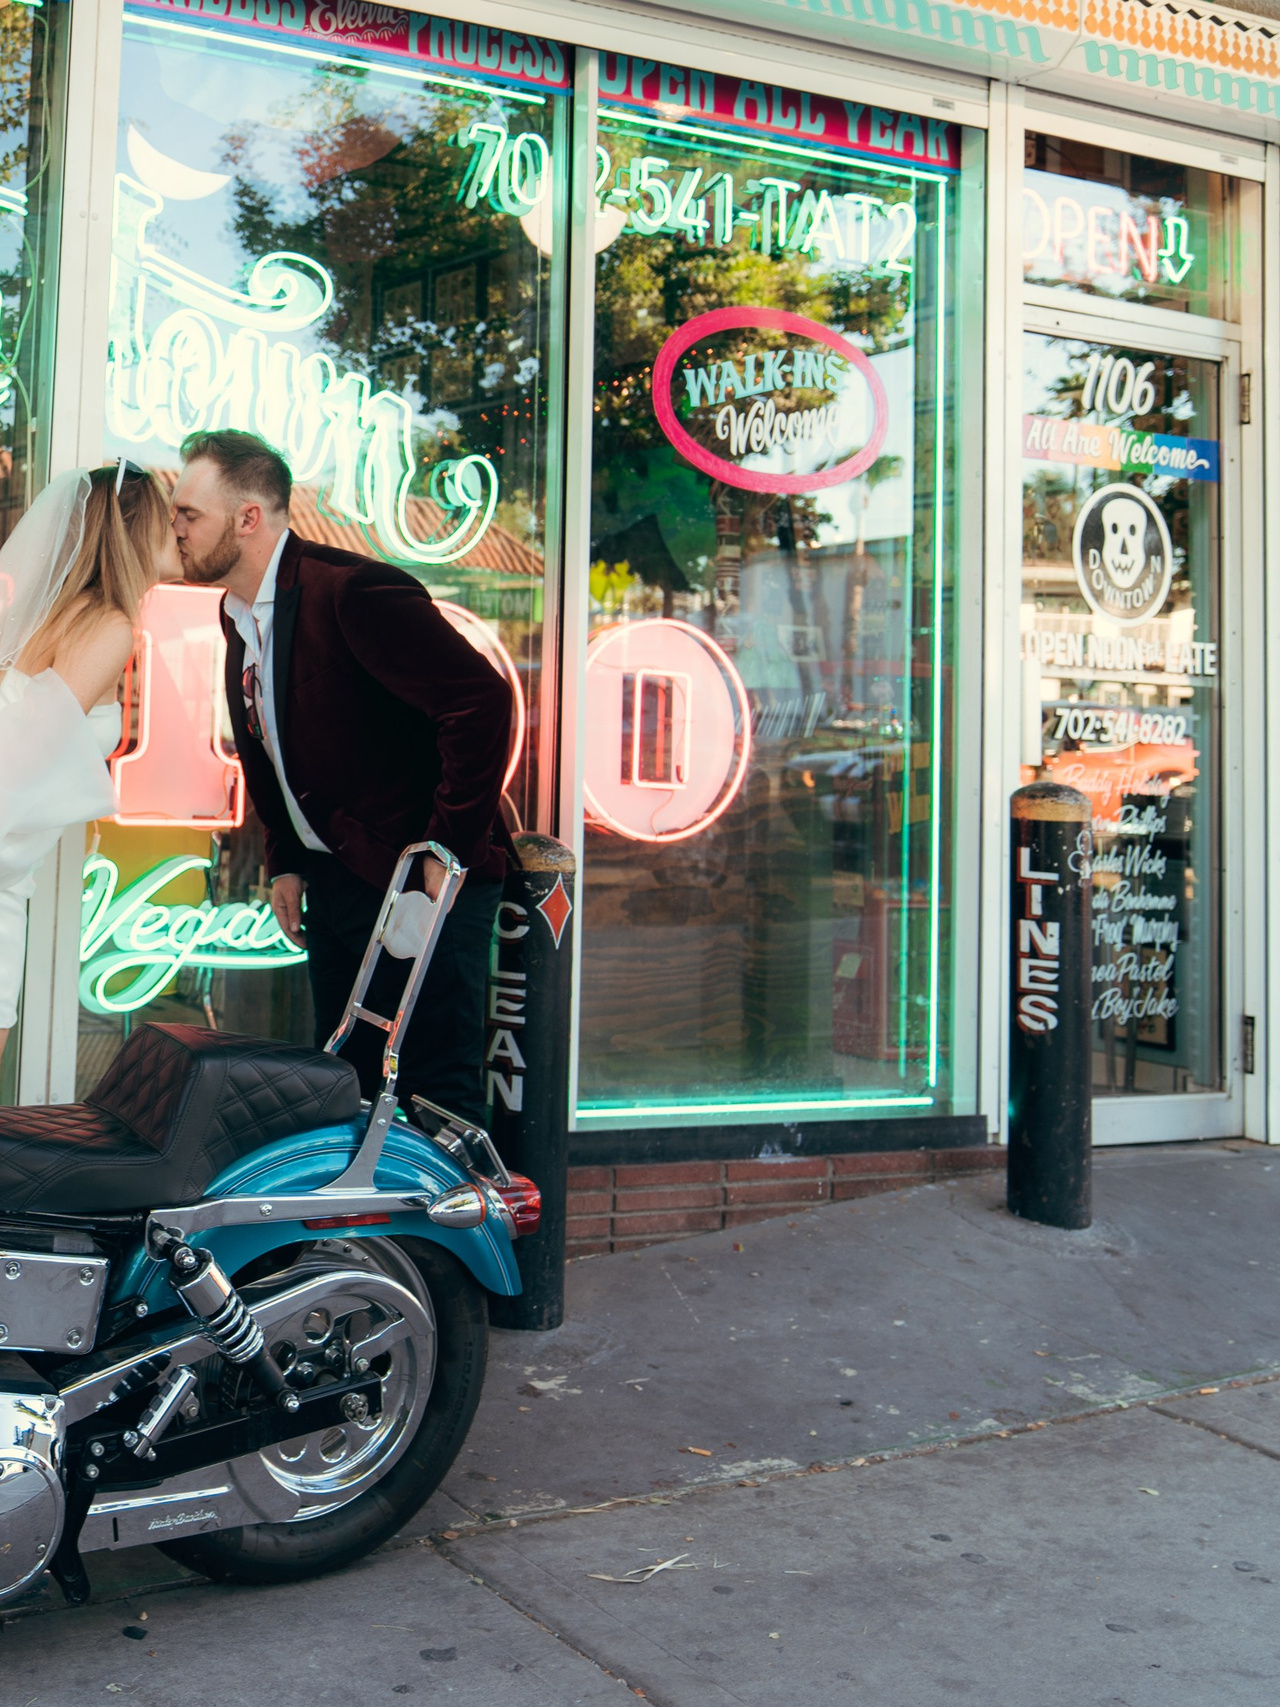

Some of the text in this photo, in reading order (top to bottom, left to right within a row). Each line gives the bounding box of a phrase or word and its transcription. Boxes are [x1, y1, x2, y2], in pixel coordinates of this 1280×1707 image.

[407, 12, 566, 84] PROCESS
[598, 50, 951, 162] OPEN ALL YEAR
[1022, 187, 1157, 283] OPEN
[683, 350, 851, 408] WALK-INS
[1081, 352, 1156, 416] 1106
[715, 397, 842, 456] Welcome
[1026, 419, 1209, 470] All Are Welcome
[1088, 548, 1162, 610] DOWNTOWN
[1026, 630, 1084, 667] OPEN
[1087, 633, 1144, 671] NOON
[1164, 640, 1217, 676] LATE
[1019, 846, 1061, 1032] LINES
[1117, 952, 1174, 983] Pastel
[486, 900, 530, 1113] CLEAN
